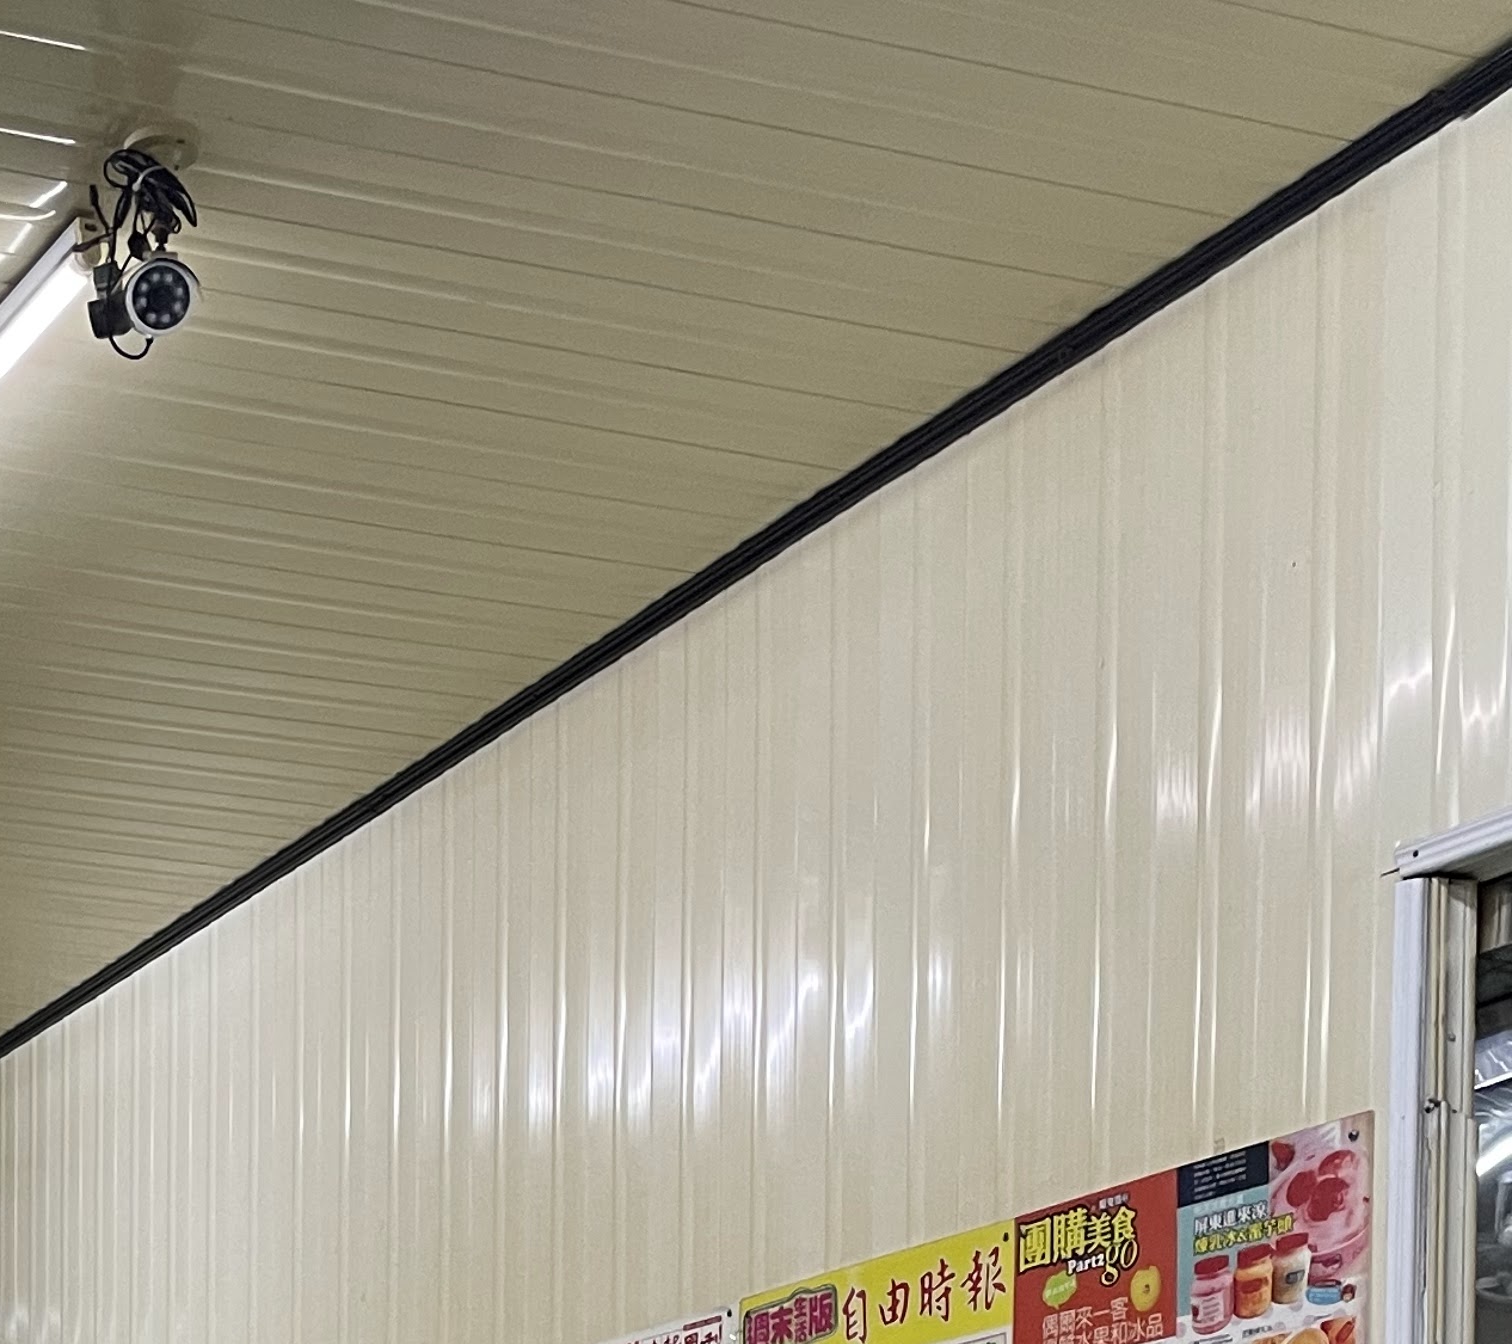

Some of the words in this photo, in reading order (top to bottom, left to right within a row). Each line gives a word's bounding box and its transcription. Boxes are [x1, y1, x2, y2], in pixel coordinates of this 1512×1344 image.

[1019, 1205, 1137, 1273] 團購美食
[842, 1246, 1007, 1344] 自由時報
[1042, 1297, 1129, 1338] 偶爾來一客
